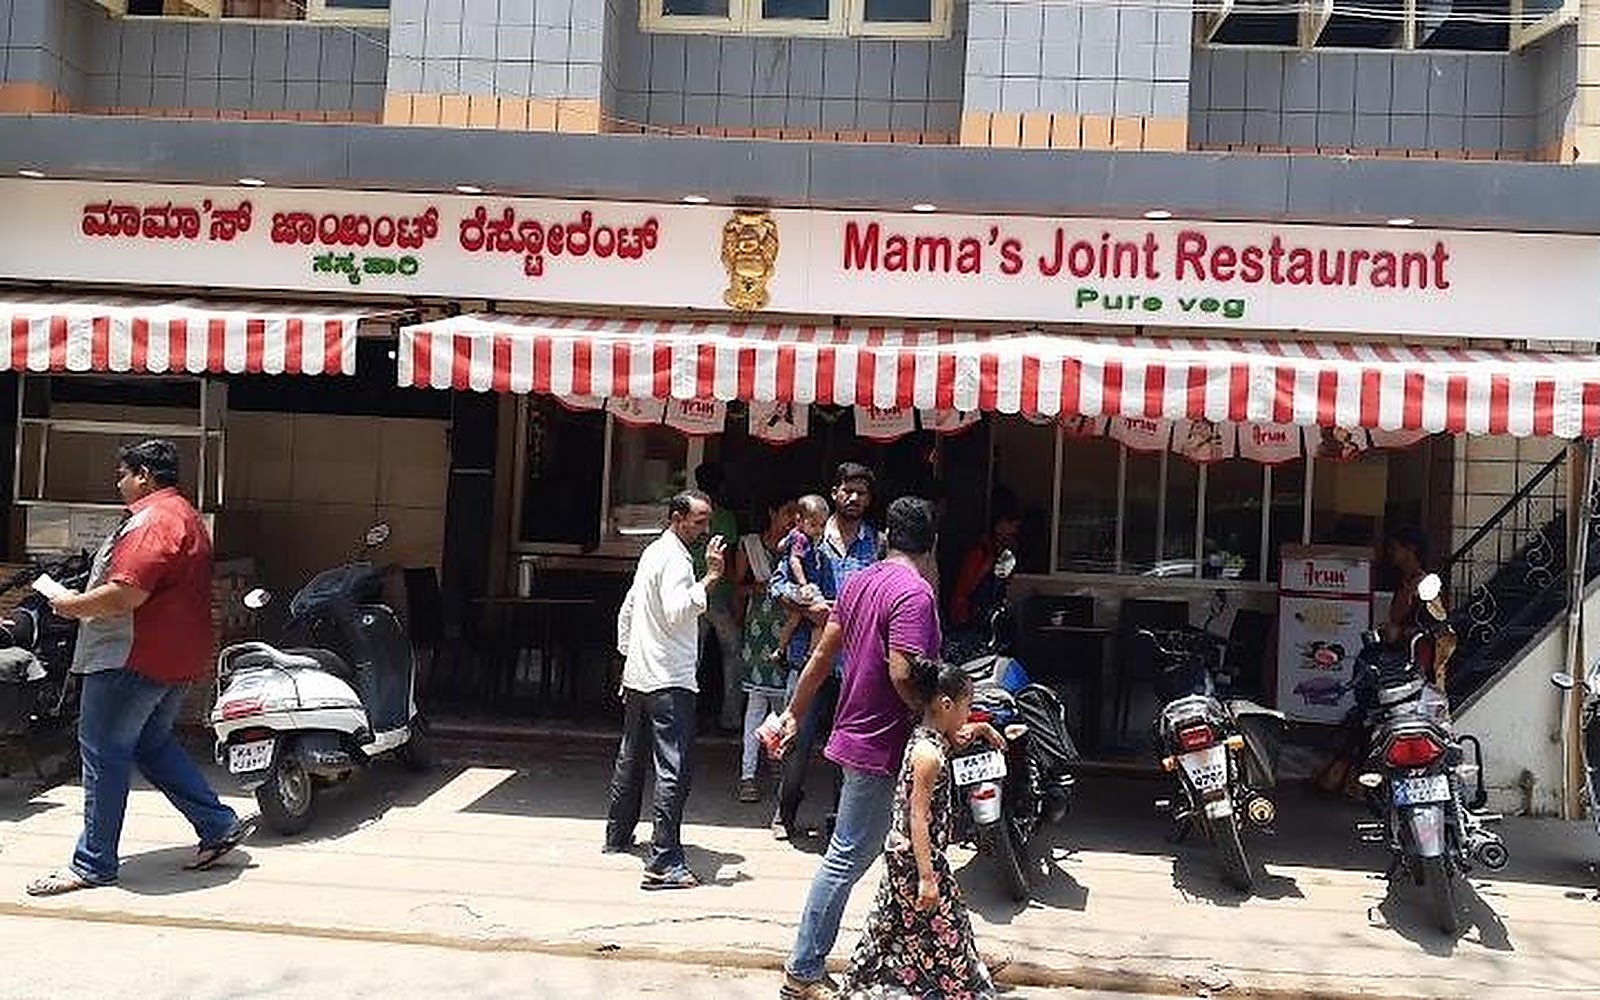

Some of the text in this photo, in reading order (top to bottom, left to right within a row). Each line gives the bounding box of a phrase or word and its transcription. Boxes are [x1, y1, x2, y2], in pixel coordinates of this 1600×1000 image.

[459, 206, 659, 277] ರೆಸ್ಟೋರೆಂಟ್
[843, 221, 1450, 290] Mama’s Joint Restaurant
[1076, 288, 1247, 319] Pure veg
